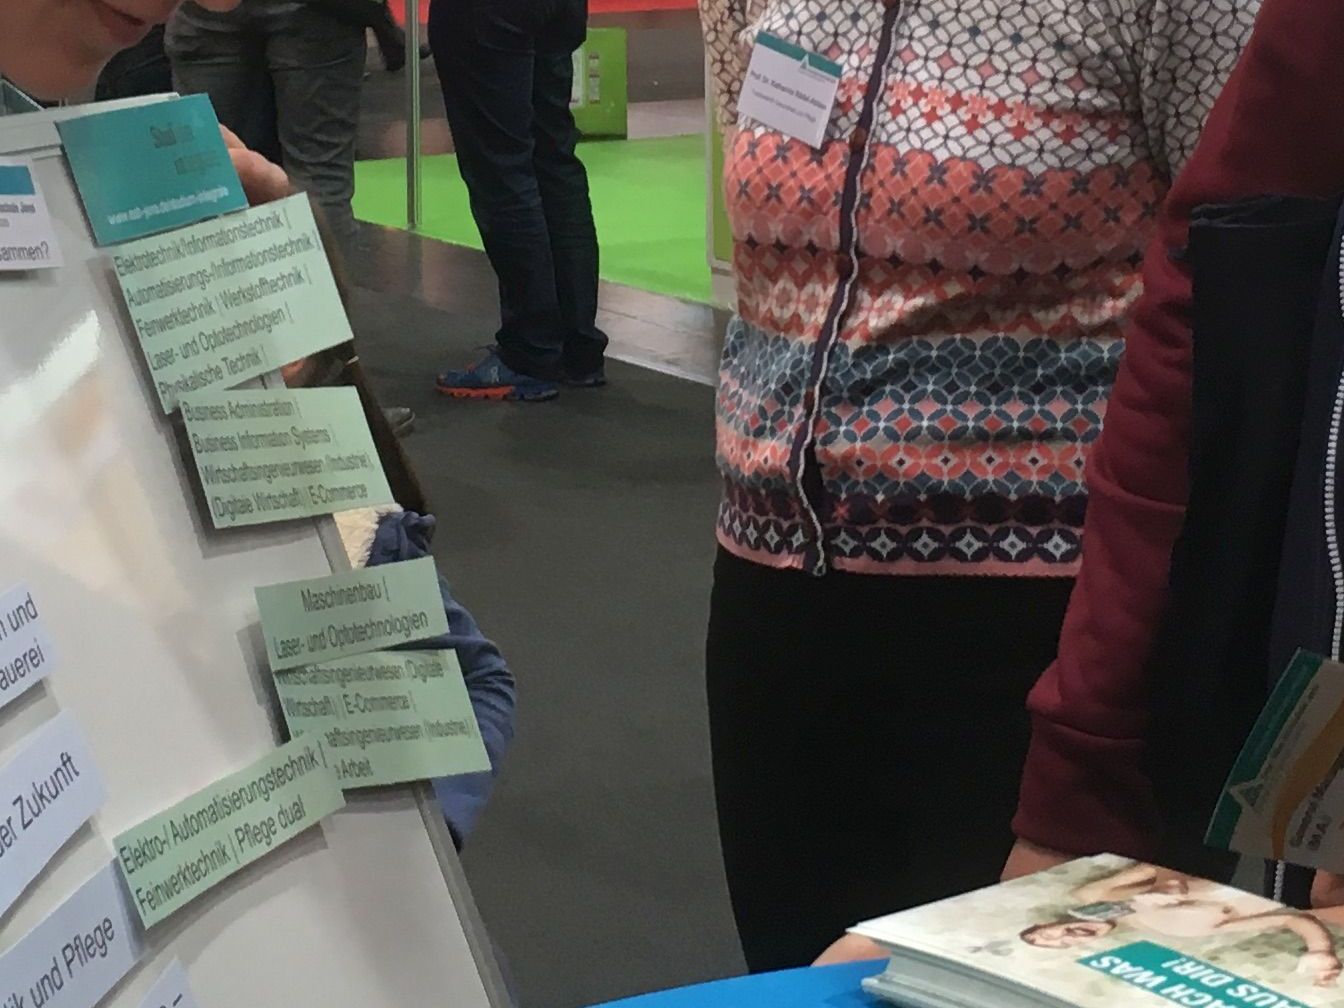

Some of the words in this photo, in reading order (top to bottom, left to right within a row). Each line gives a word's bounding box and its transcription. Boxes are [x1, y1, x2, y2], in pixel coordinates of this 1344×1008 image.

[138, 297, 217, 339] Feinwerktechnik
[146, 346, 180, 372] Laser-
[181, 338, 200, 361] und
[198, 307, 287, 353] Optotechnologien
[221, 347, 264, 376] Technik
[308, 482, 369, 506] E-Commerce
[7, 591, 39, 633] und
[300, 582, 382, 613] Maschinenbau
[273, 636, 305, 661] Laser-
[305, 632, 326, 653] und
[326, 609, 430, 652] Optotechnologien
[342, 692, 411, 715] E-Commerce
[12, 749, 81, 831] Zukunft
[168, 745, 321, 846] Automatisierungstechnik
[135, 840, 232, 918] Feinwerktechnik
[234, 814, 279, 854] Pflege
[277, 794, 308, 829] dual
[30, 956, 64, 1008] und
[61, 916, 116, 979] Pflege
[1090, 954, 1169, 990] WAS
[1160, 956, 1235, 988] DIR!
